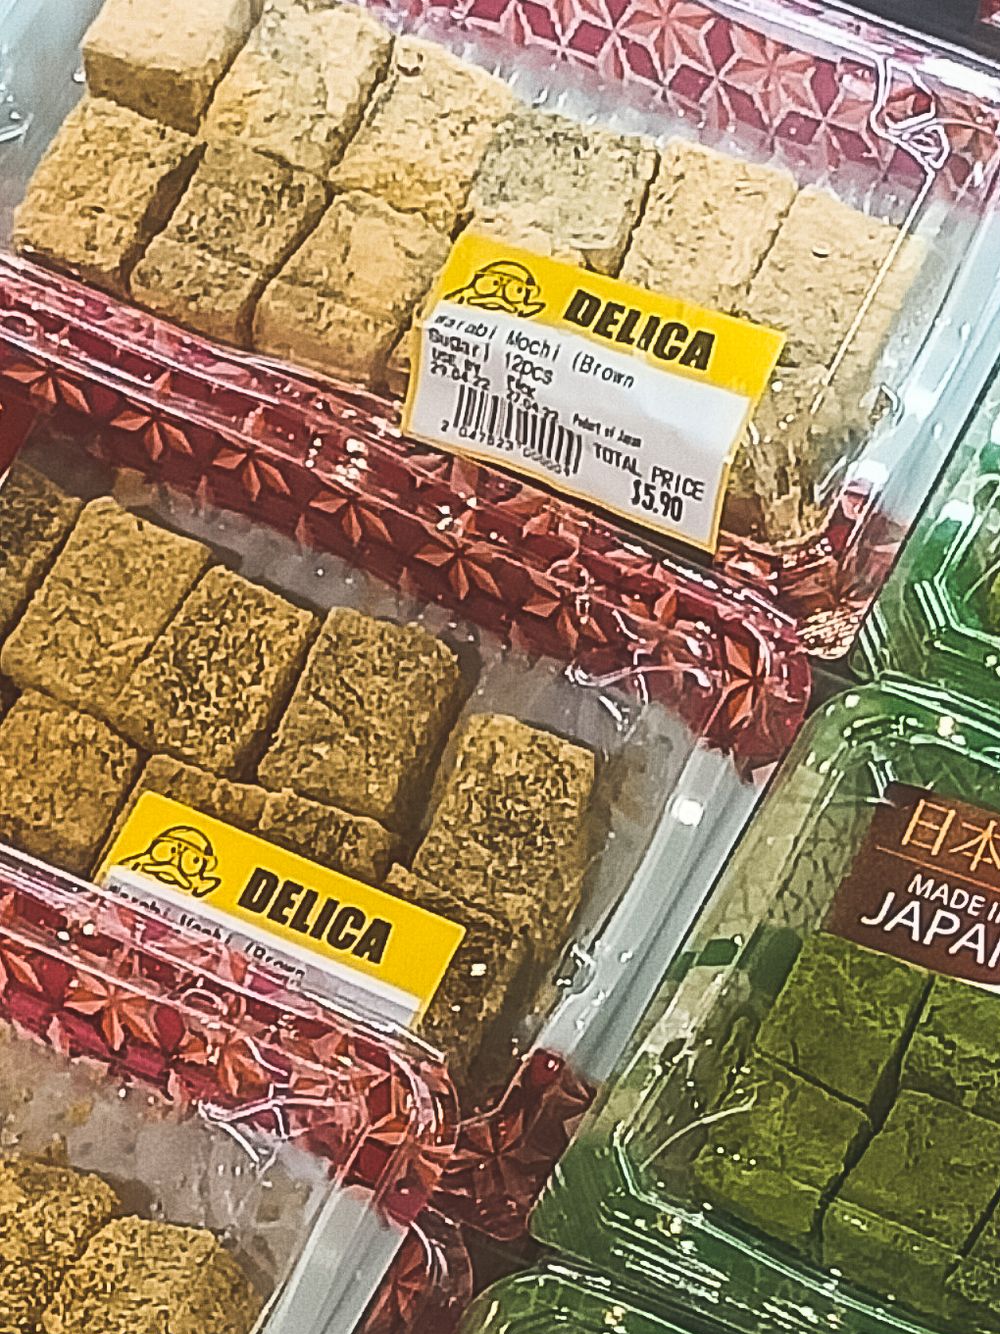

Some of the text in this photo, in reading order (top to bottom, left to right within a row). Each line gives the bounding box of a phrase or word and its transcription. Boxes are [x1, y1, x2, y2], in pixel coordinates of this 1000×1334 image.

[563, 288, 716, 371] DELICA
[505, 351, 554, 385] 12pcs
[506, 330, 561, 362] Mochi
[572, 348, 635, 390] (Brown
[593, 442, 706, 502] TOTAL PRICE
[631, 479, 684, 522] $5.90
[236, 866, 393, 965] DELICA
[907, 872, 986, 916] MADE
